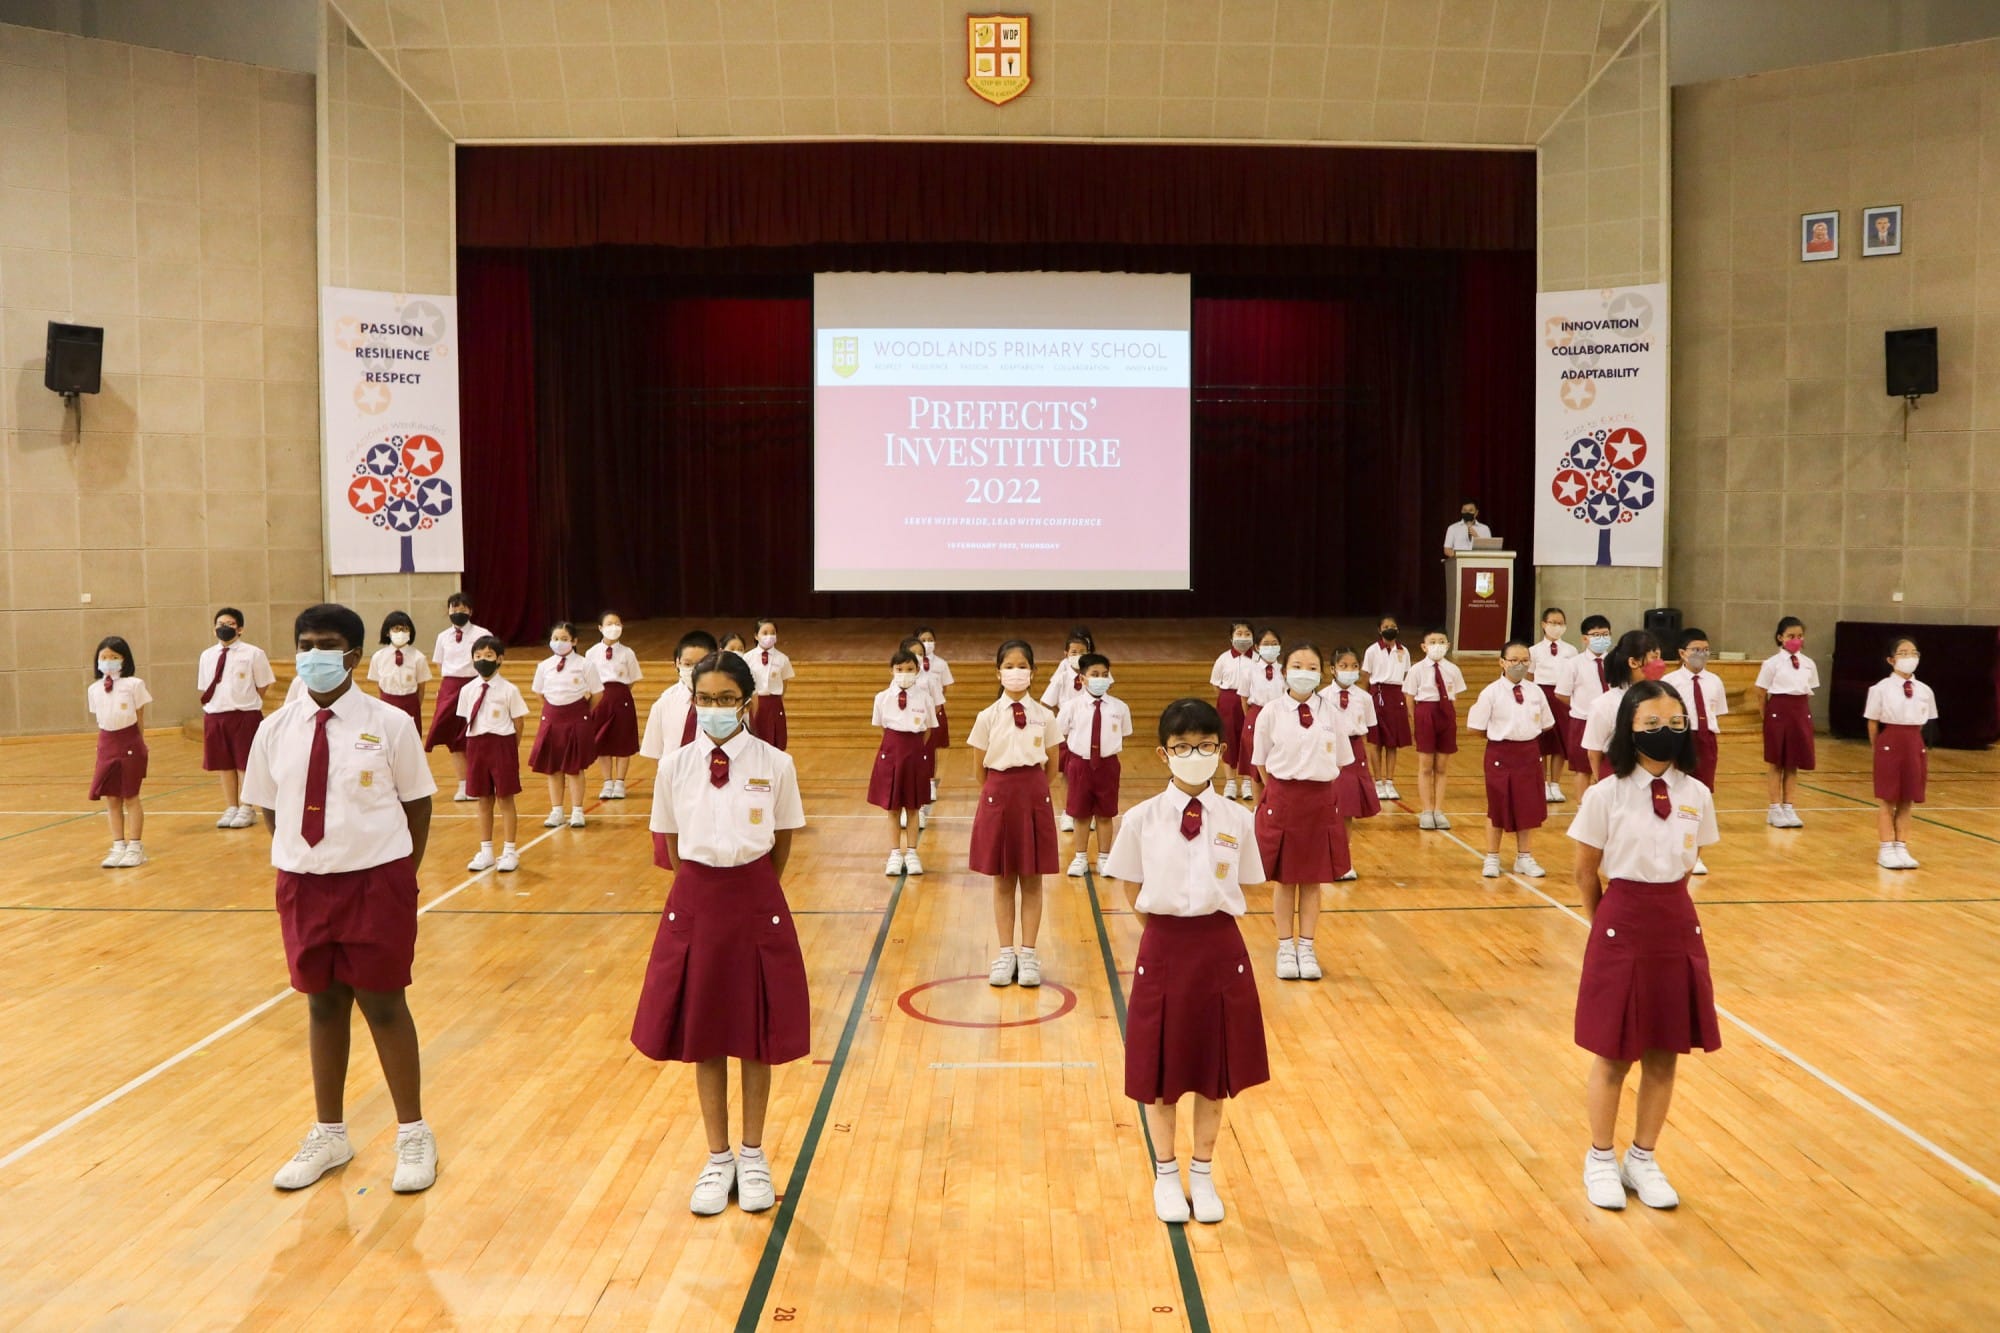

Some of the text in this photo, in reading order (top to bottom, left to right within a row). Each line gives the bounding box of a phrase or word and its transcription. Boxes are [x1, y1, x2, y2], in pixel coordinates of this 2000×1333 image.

[360, 323, 424, 336] PASSION
[1561, 318, 1639, 332] INNOVATION
[355, 347, 430, 361] RESILIENCE
[873, 341, 1167, 359] WOODLANDS PRIMARY SCHOOL
[1551, 342, 1650, 356] COLLABORATION
[365, 372, 421, 384] RESPECT
[1561, 367, 1640, 380] ADAPTABILITY
[884, 433, 1121, 468] INVESTITURE
[965, 478, 1041, 504] 2022
[991, 517, 1016, 526] LEAD
[1018, 517, 1041, 526] WITH
[1043, 517, 1104, 527] CONFIDENCE
[773, 1307, 797, 1322] 28
[1152, 1305, 1173, 1313] 8
